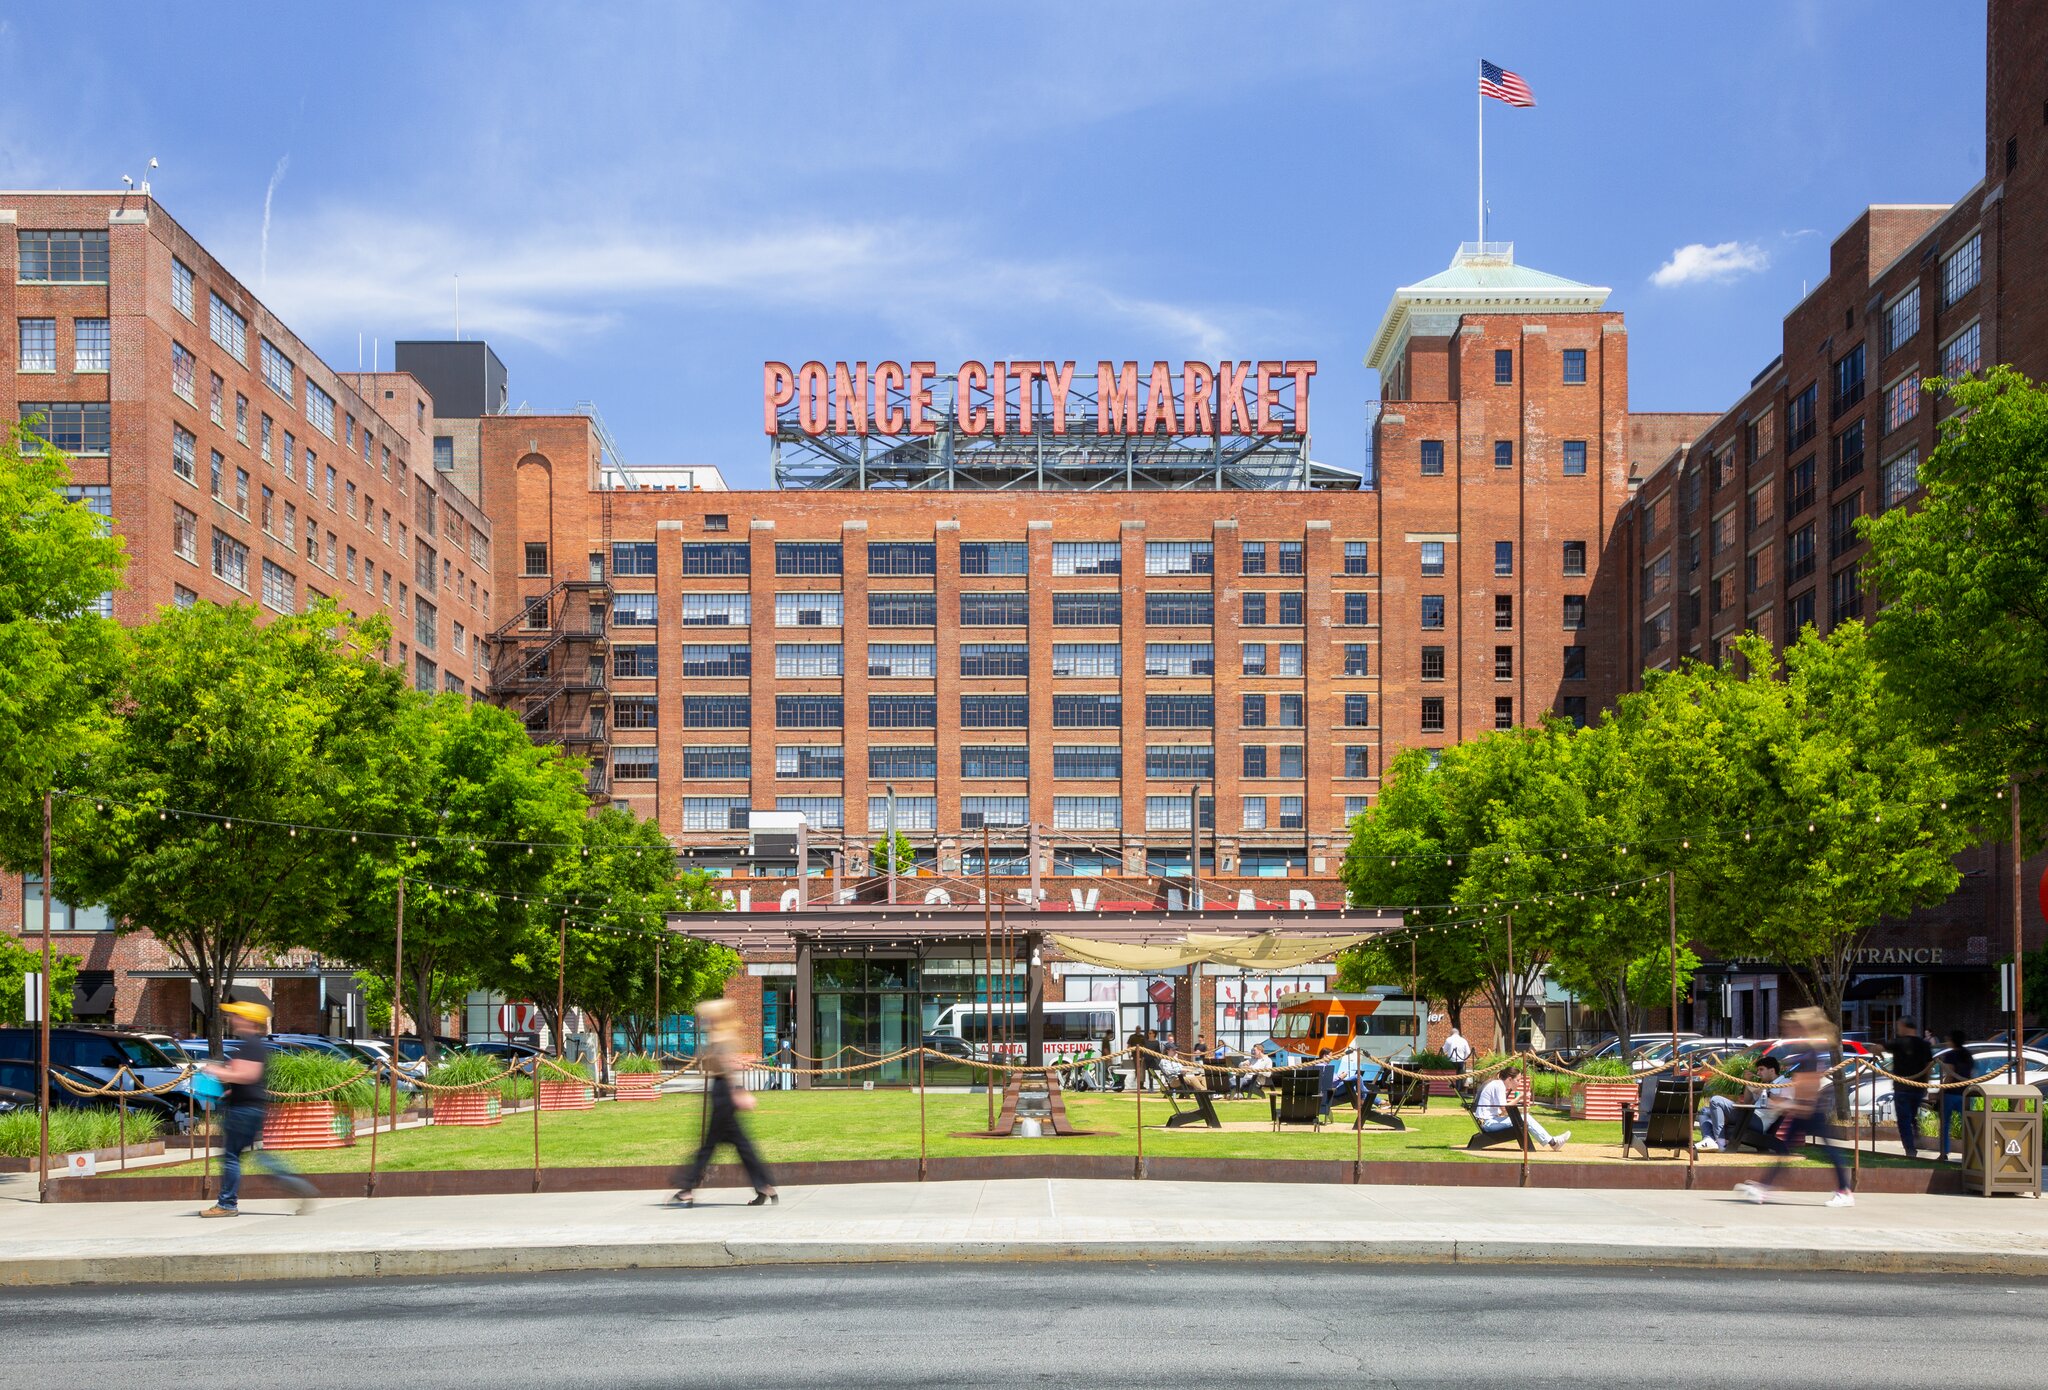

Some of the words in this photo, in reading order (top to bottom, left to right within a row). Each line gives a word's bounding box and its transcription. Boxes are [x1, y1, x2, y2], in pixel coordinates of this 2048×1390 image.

[764, 361, 936, 436] PONCE
[957, 361, 1076, 436] CITY
[1097, 361, 1317, 436] MARKET
[981, 1044, 1024, 1054] ALANTA
[1043, 1042, 1093, 1054] HTSEEING
